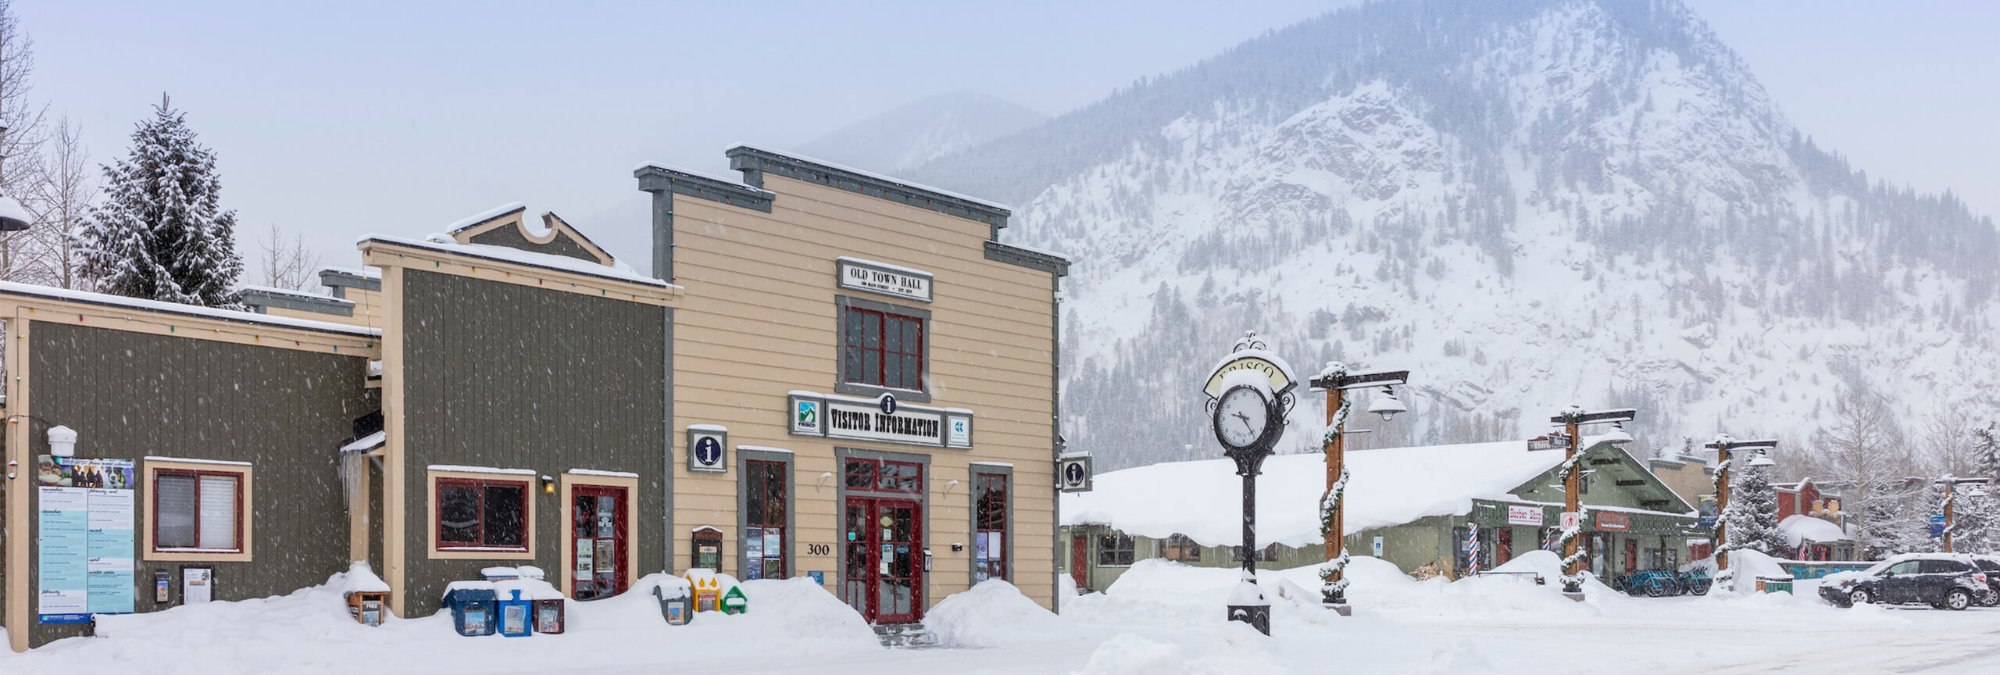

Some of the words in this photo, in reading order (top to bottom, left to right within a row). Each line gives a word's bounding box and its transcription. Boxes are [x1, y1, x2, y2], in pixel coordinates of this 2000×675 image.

[850, 267, 868, 280] OLD
[872, 271, 897, 285] TOWN
[901, 276, 922, 290] HALL
[831, 408, 871, 432] VISITOR
[875, 412, 939, 438] INFORMATION
[807, 543, 830, 556] 300
